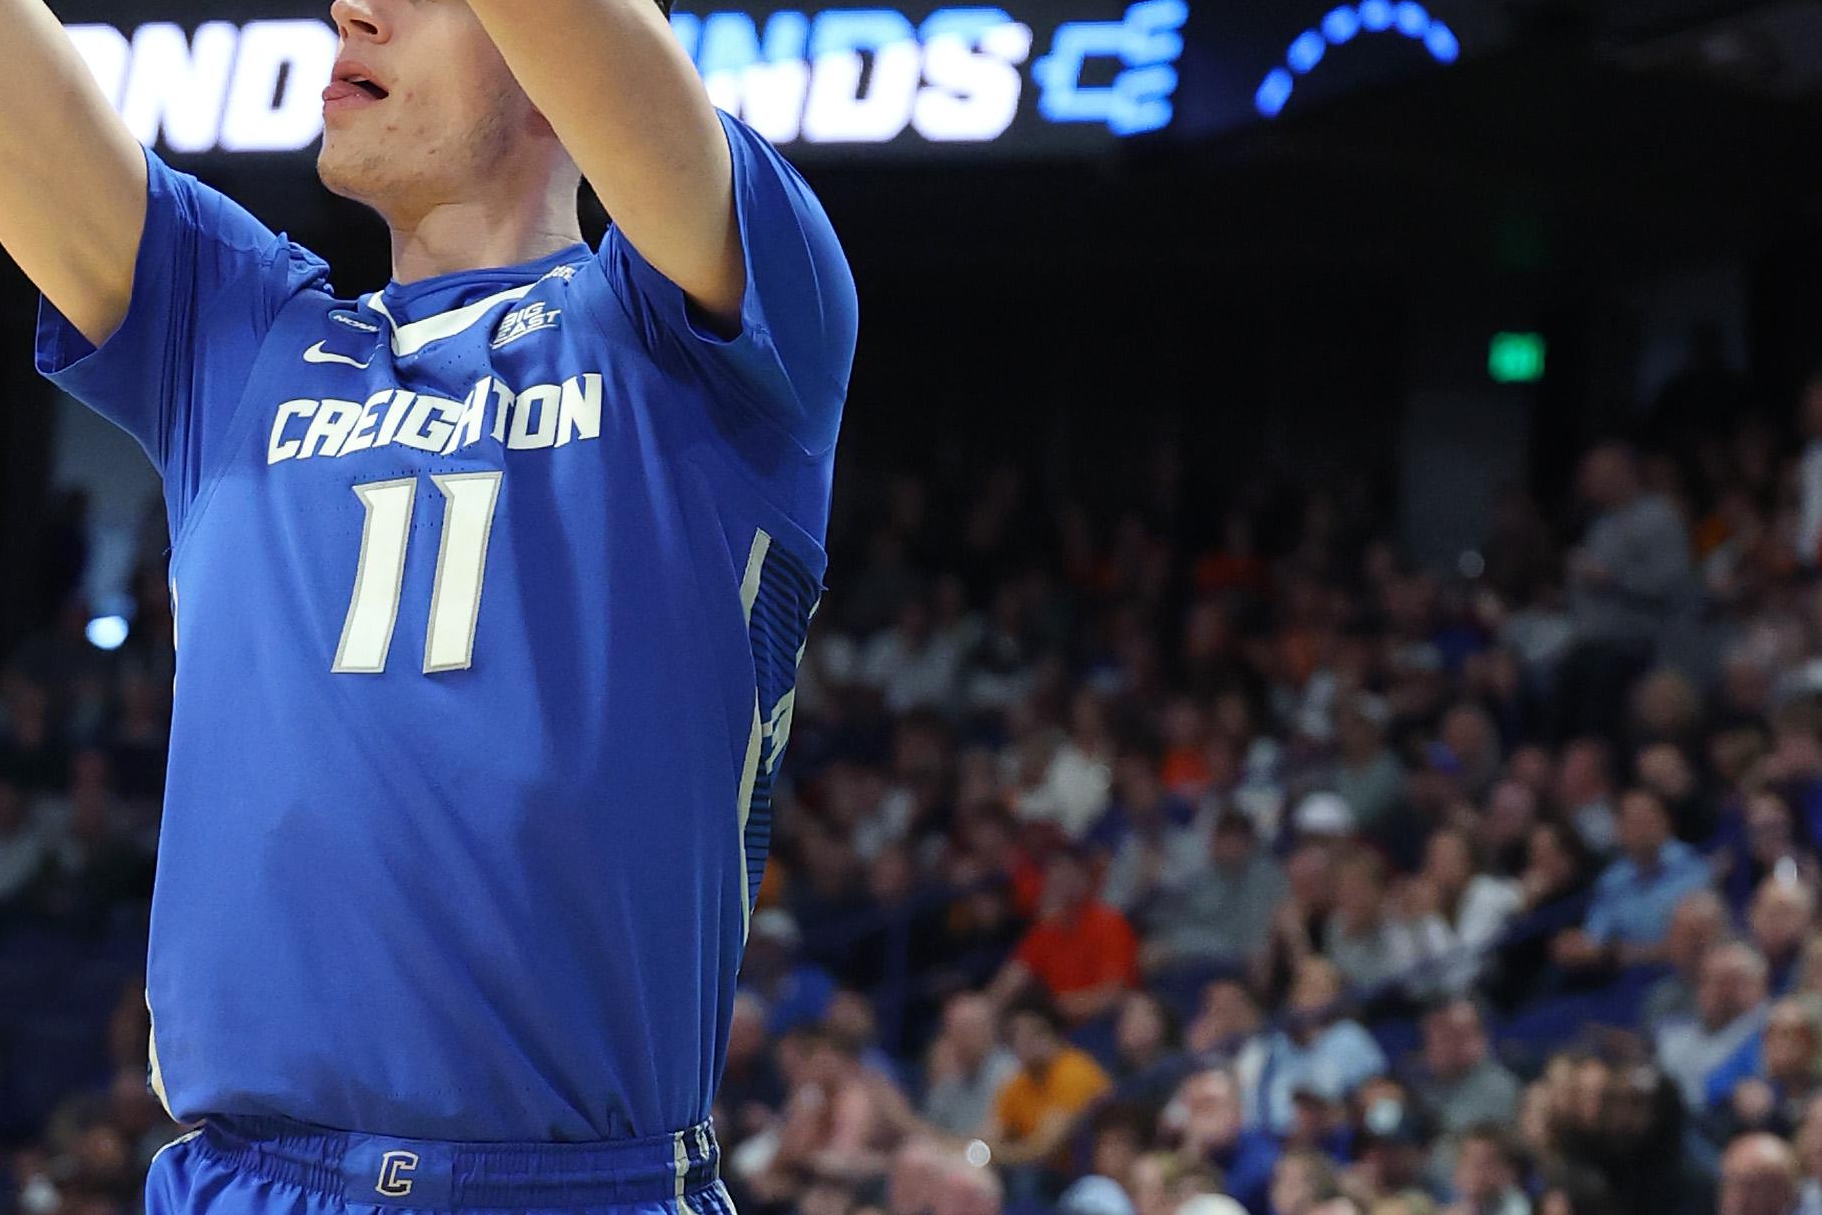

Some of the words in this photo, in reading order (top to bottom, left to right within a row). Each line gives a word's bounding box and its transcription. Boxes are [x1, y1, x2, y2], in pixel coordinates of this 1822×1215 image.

[500, 301, 546, 325] BIG
[267, 374, 603, 464] CREIGHTON
[330, 470, 505, 674] 11
[376, 1150, 420, 1197] C
